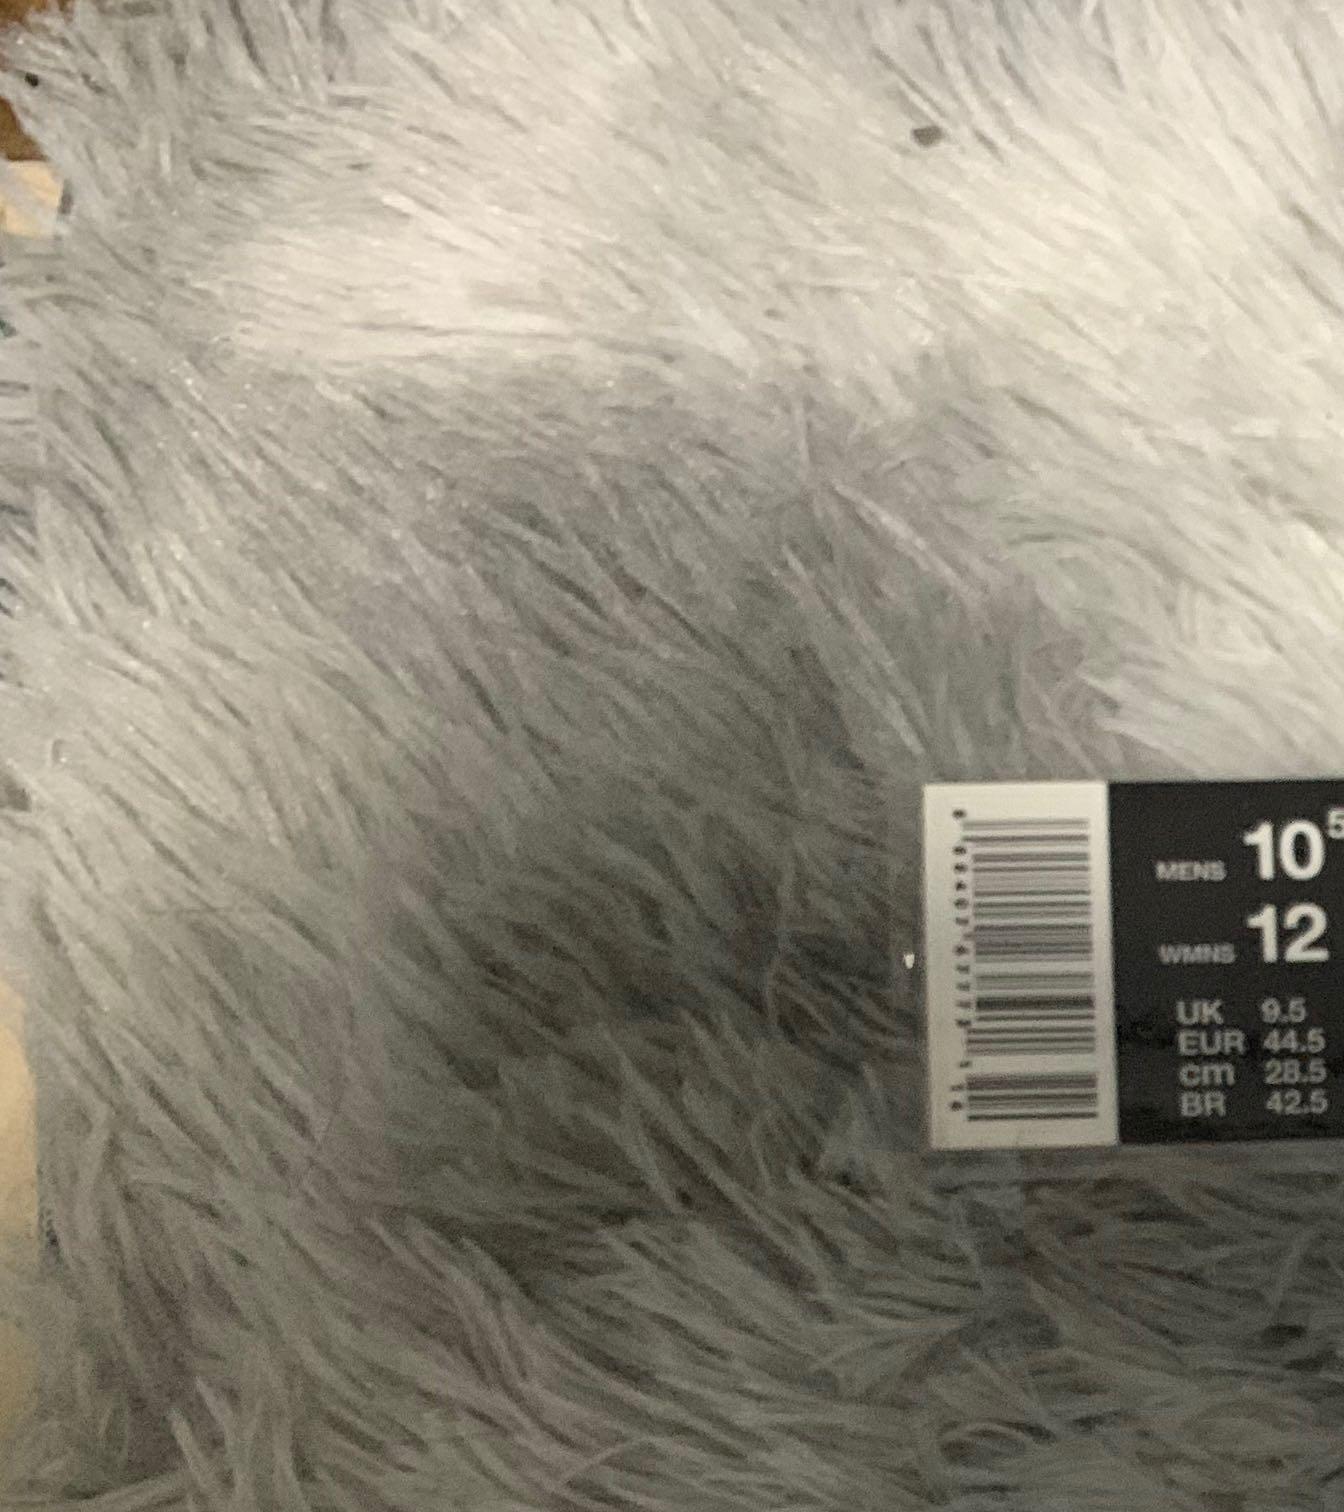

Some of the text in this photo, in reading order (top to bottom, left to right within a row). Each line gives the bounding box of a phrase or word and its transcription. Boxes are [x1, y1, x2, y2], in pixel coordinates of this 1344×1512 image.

[1155, 860, 1226, 881] MENS
[1243, 819, 1326, 882] 10
[1159, 902, 1330, 964] WMNS 12
[1175, 998, 1306, 1025] UK 9.5
[1177, 1028, 1326, 1056] EUR 44.5
[1179, 1059, 1327, 1086] cm 28.5
[1180, 1088, 1328, 1117] BR 42.5
